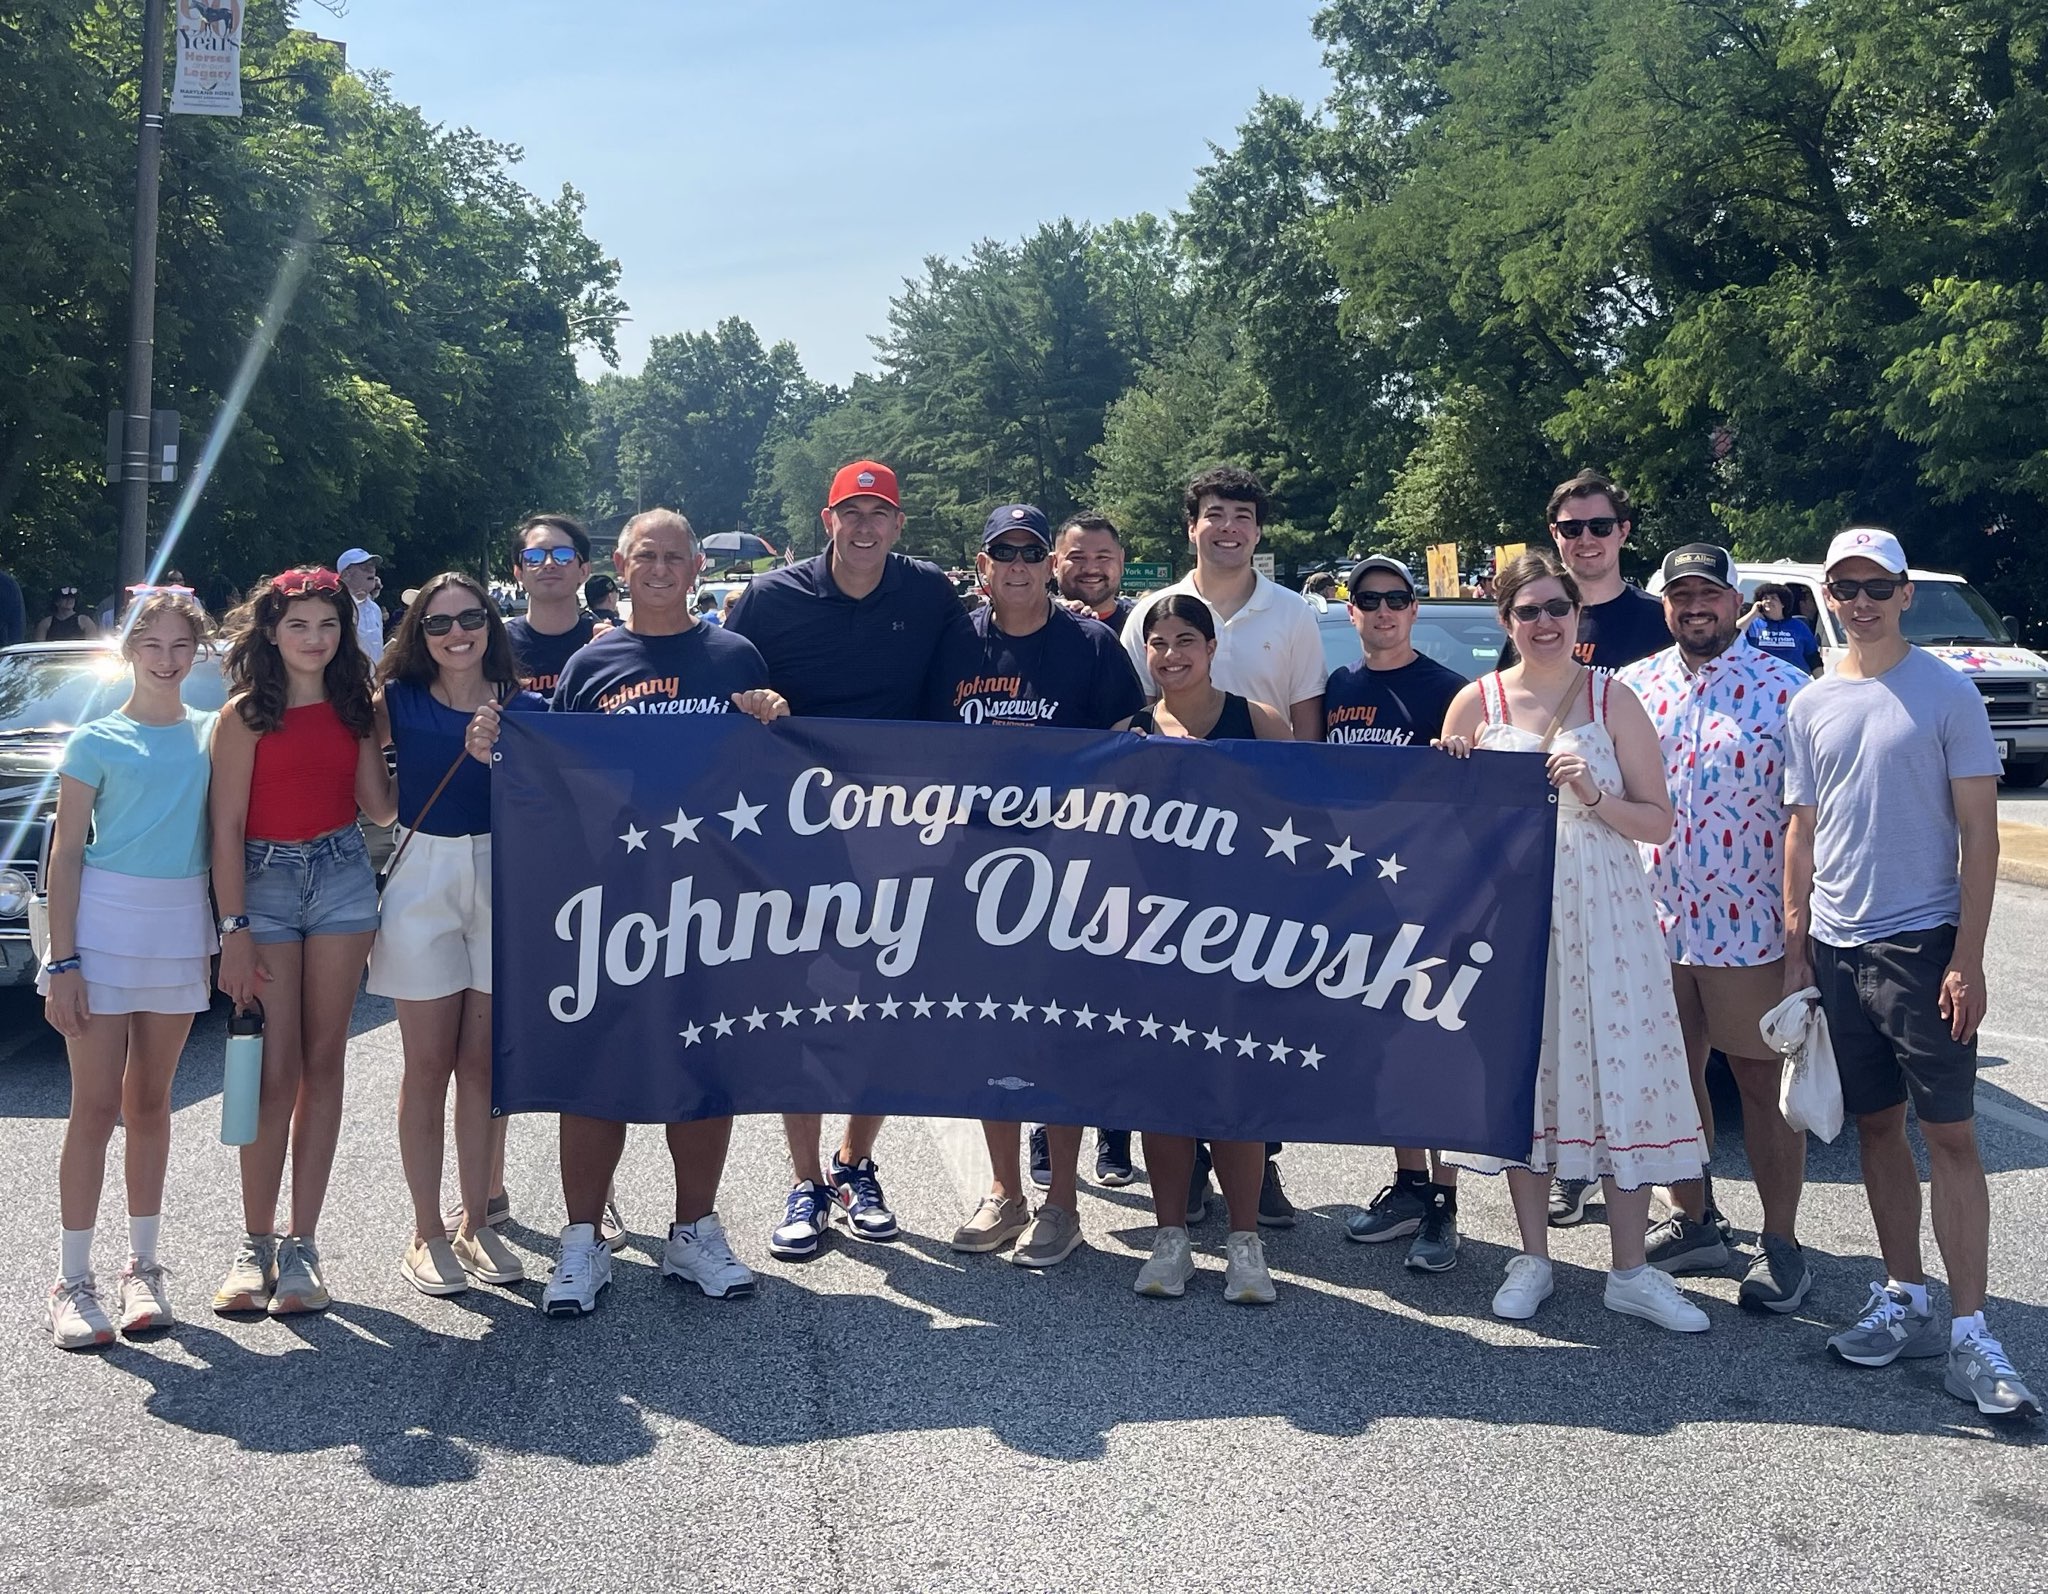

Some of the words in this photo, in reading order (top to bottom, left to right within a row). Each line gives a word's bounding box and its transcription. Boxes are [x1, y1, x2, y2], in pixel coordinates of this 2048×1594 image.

[179, 29, 240, 51] Years
[185, 52, 231, 63] Horses
[184, 66, 232, 81] Legacy
[1124, 567, 1142, 576] York
[1158, 569, 1167, 577] 45
[598, 677, 680, 714] Johnny
[953, 676, 1021, 706] Johnny
[959, 697, 1060, 725] Olszewski
[787, 767, 1239, 856] Congressman
[548, 875, 935, 1024] Johnny
[964, 847, 1494, 1032] Olszewski
